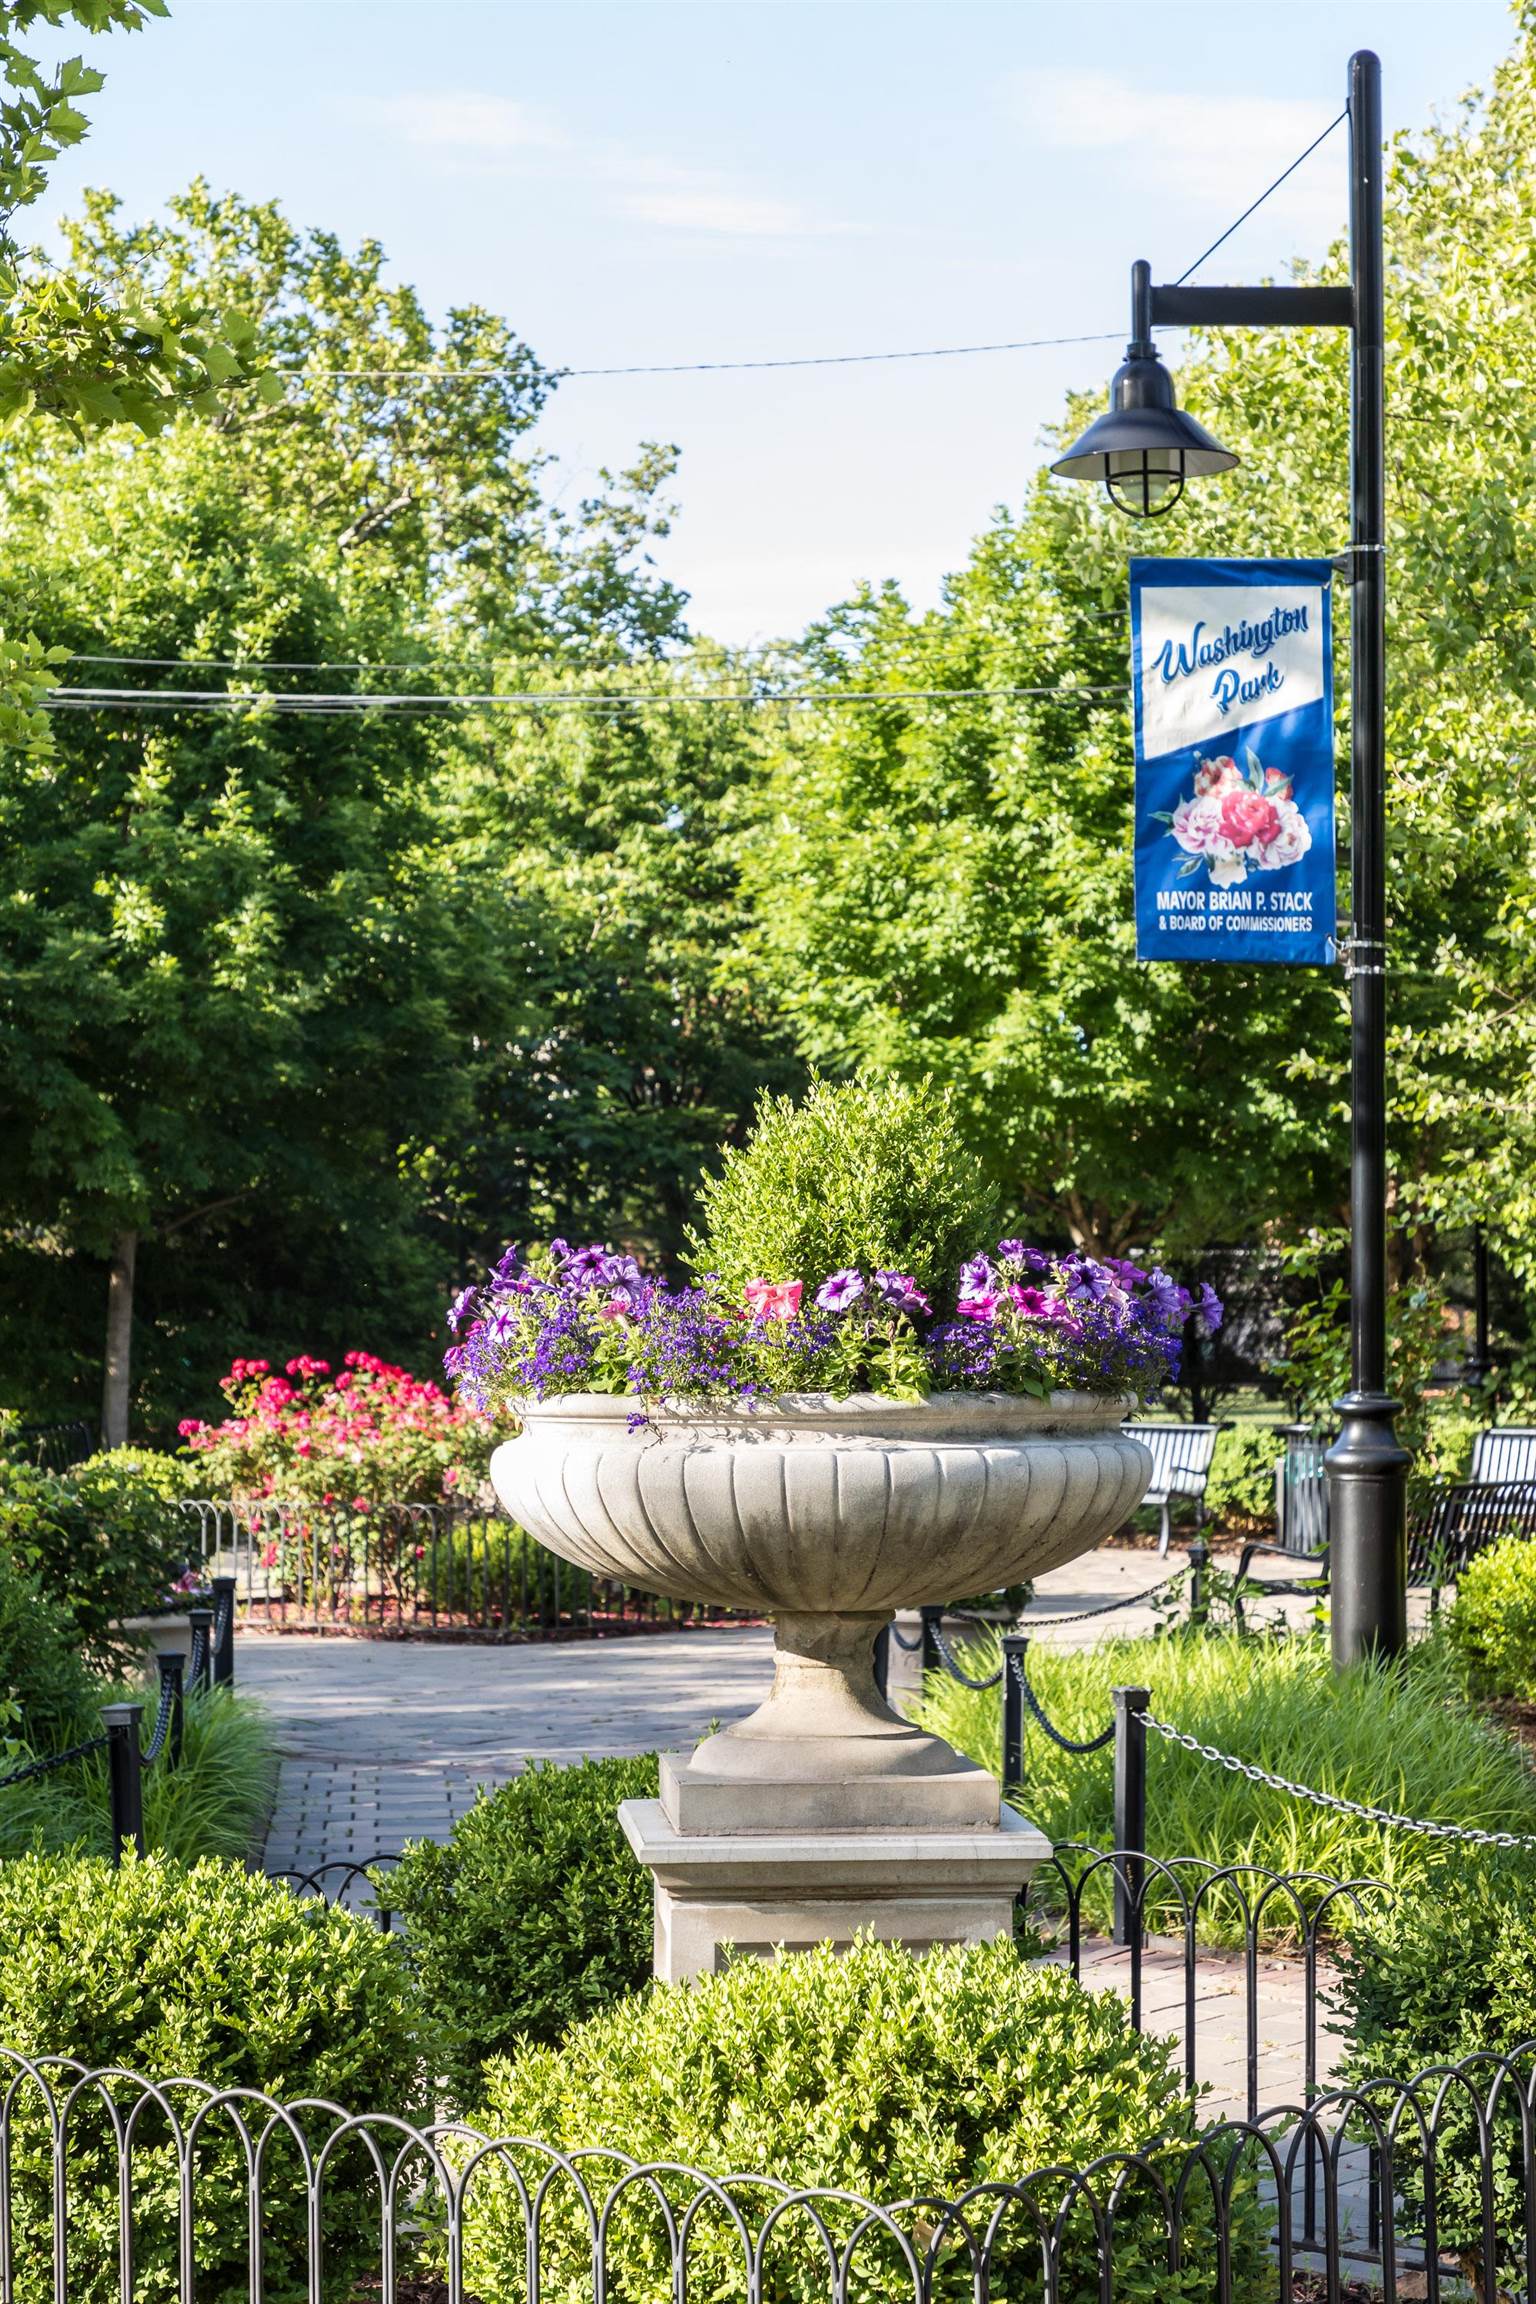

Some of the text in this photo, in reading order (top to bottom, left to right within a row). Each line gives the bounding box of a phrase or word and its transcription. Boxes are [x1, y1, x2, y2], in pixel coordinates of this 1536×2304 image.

[1151, 605, 1310, 684] Washington
[1211, 661, 1284, 715] Park
[1156, 891, 1313, 912] MAYOR BRIAN P. STACK
[1159, 915, 1312, 932] & BOARD OF COMMISSIONERS
